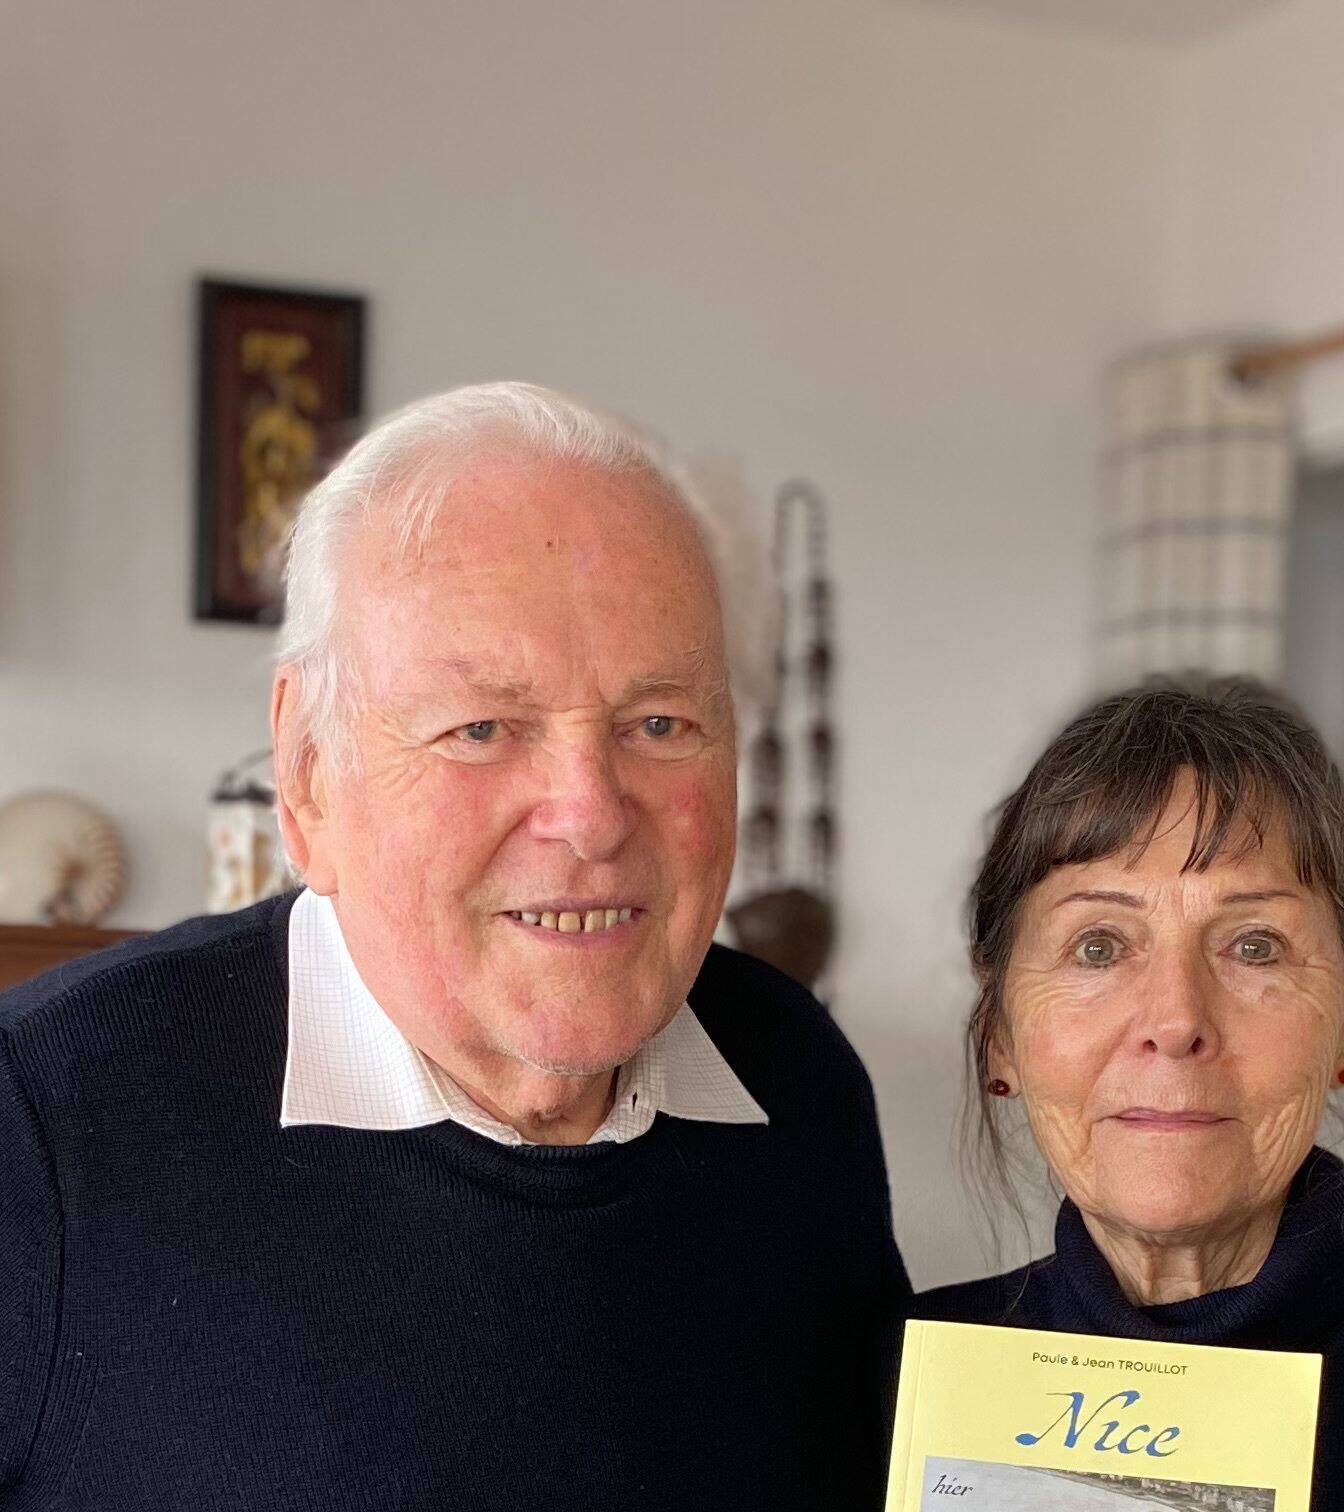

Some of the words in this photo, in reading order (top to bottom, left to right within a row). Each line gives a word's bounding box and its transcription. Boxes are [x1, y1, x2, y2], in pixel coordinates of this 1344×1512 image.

[1032, 1352, 1068, 1365] Paule
[1071, 1356, 1079, 1366] &
[1082, 1357, 1115, 1369] Jean
[1118, 1360, 1189, 1376] TROUILLOT
[1015, 1390, 1180, 1457] Nice
[932, 1474, 974, 1496] hier
